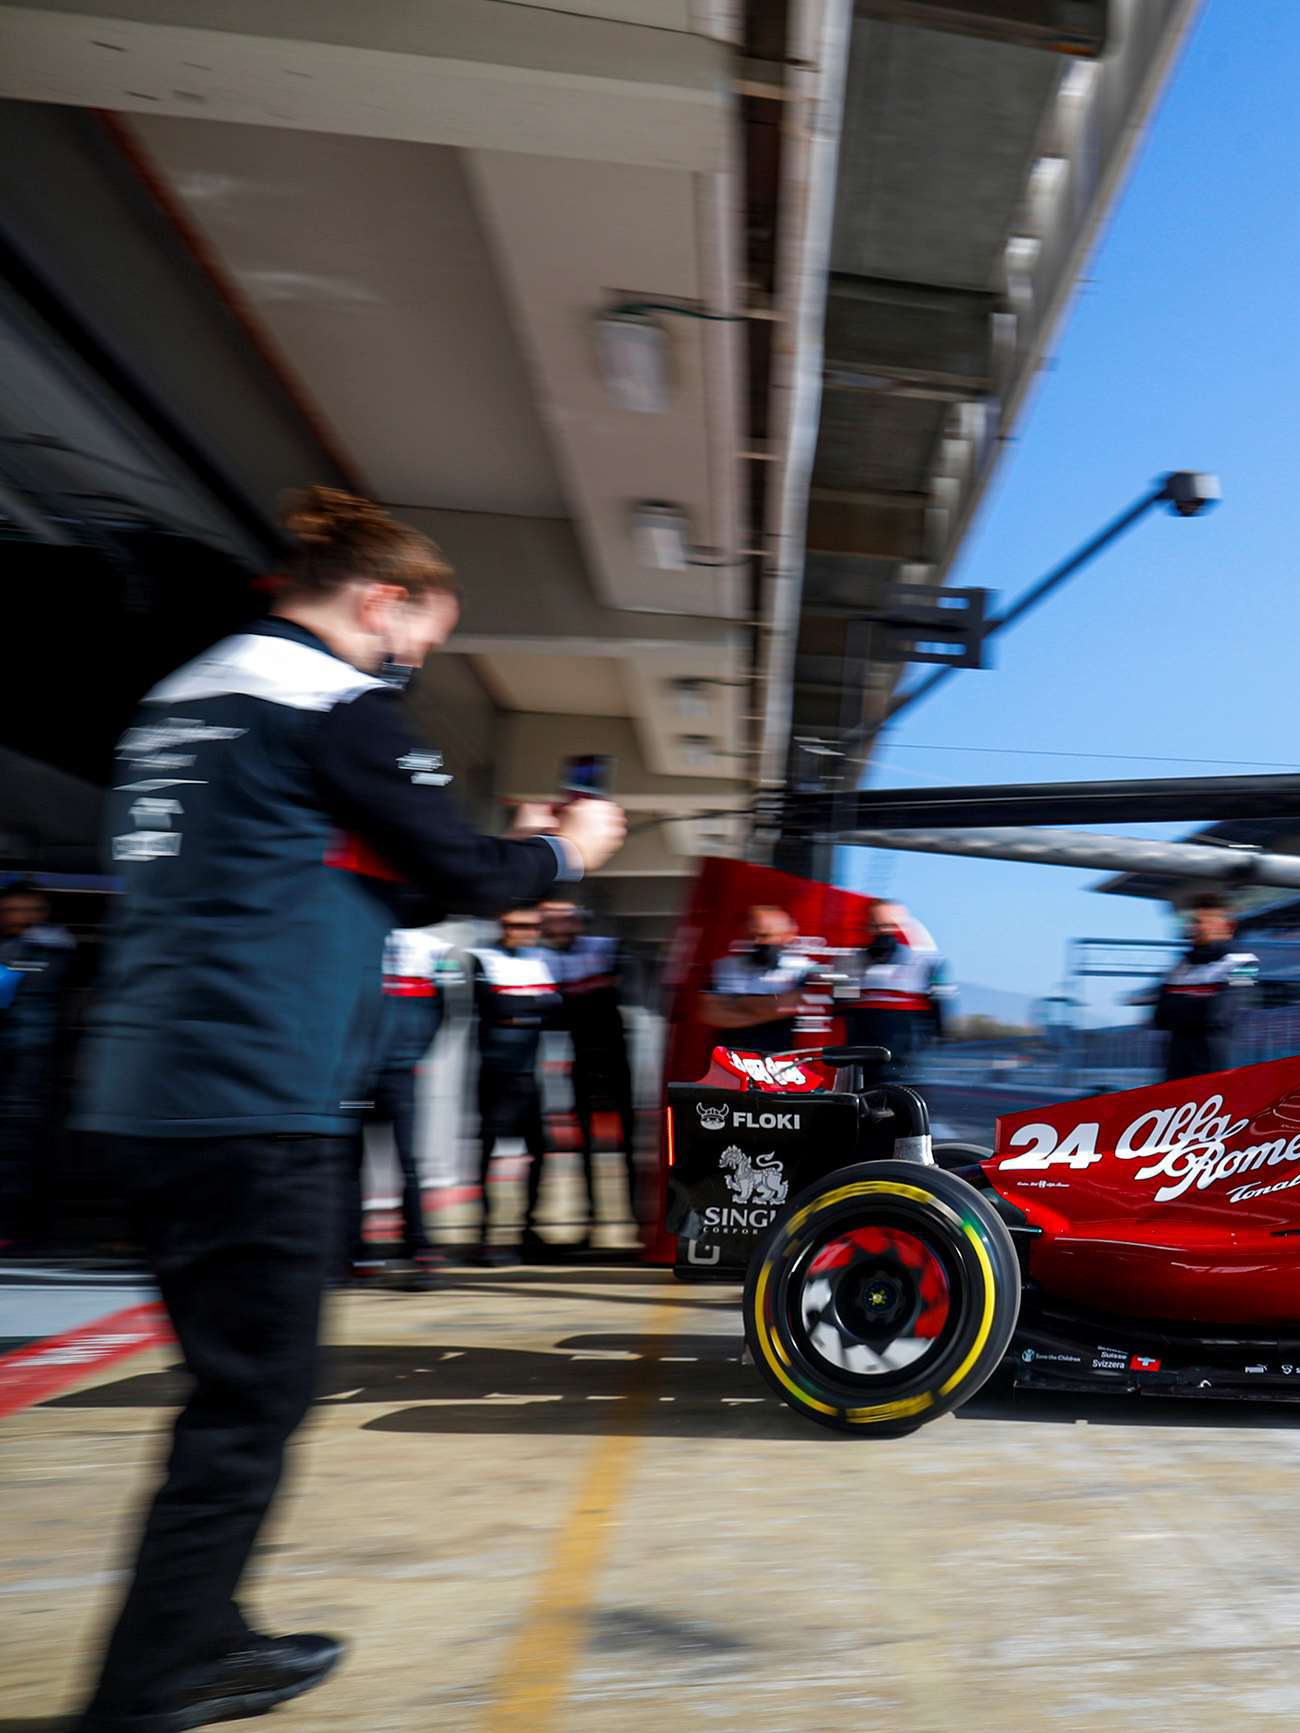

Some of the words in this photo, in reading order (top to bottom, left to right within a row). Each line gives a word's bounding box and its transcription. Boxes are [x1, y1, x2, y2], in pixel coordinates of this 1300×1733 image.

[733, 1111, 800, 1130] FLOKI
[1114, 1094, 1249, 1159] Alfa
[999, 1123, 1103, 1170] 24
[703, 1226, 758, 1235] CORPOR
[1092, 1359, 1125, 1369] Svizzera
